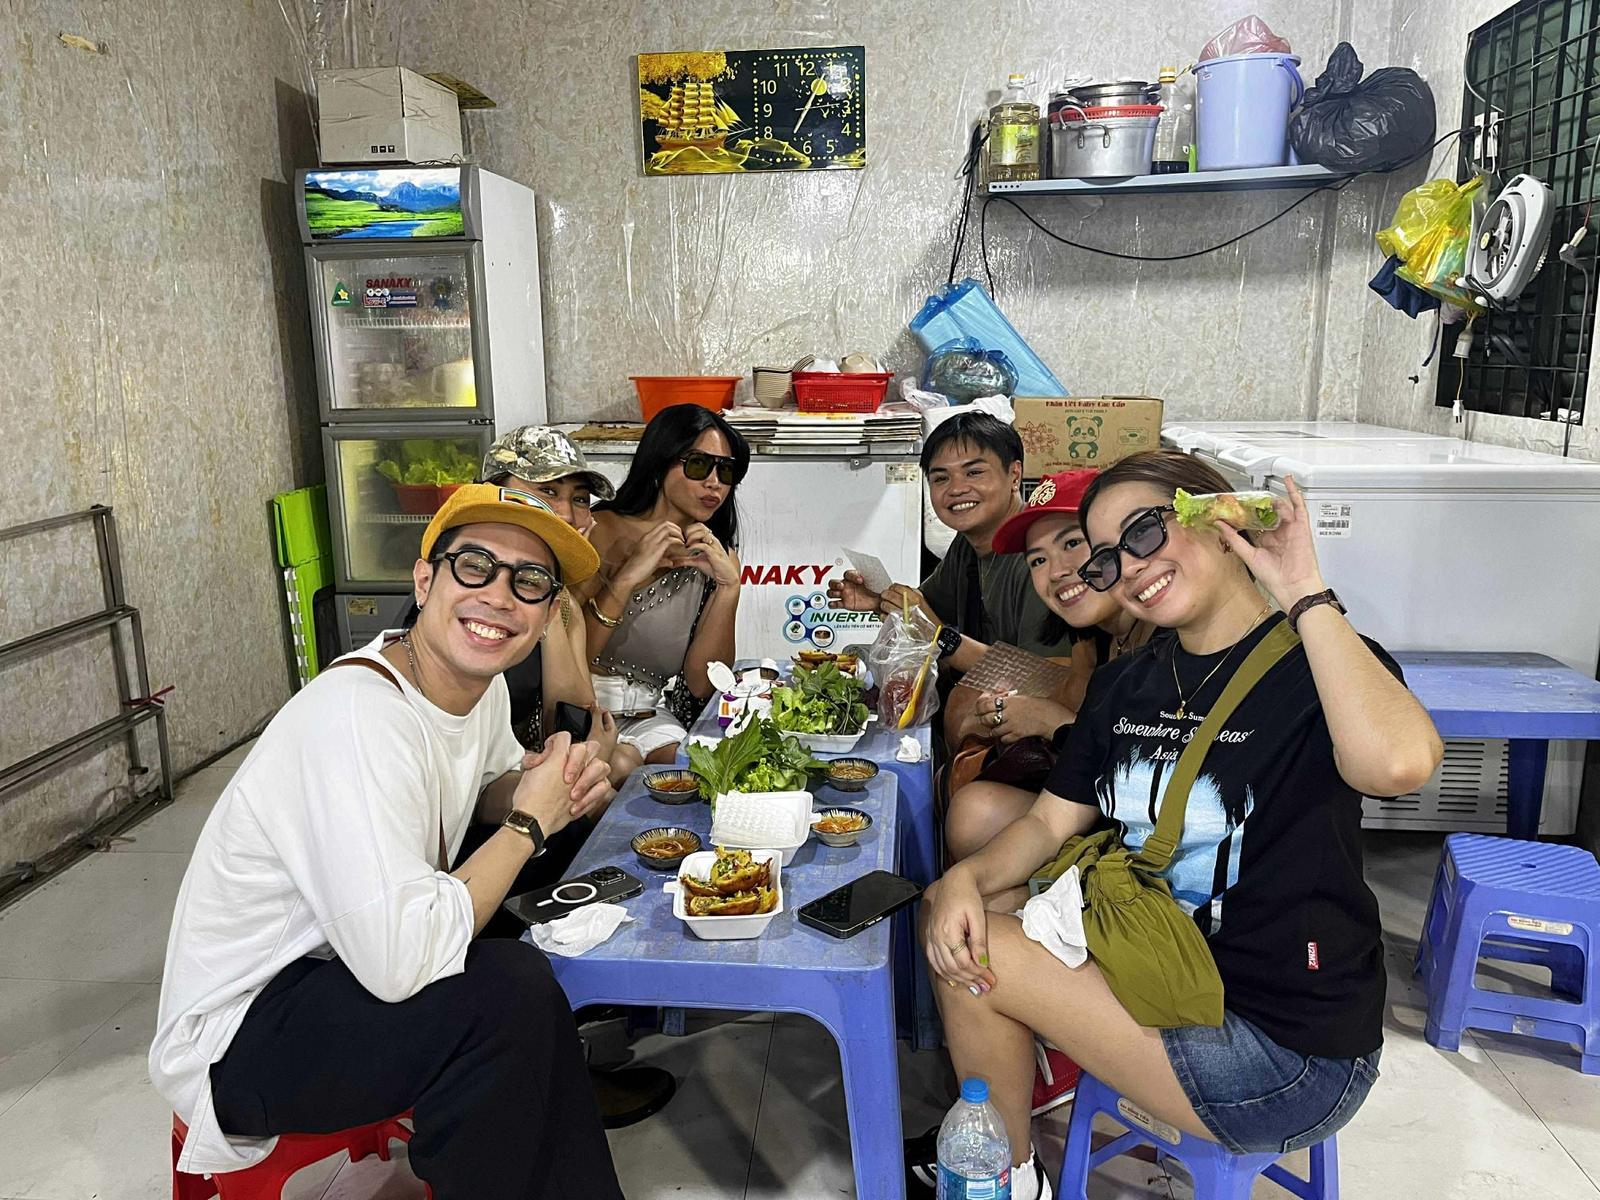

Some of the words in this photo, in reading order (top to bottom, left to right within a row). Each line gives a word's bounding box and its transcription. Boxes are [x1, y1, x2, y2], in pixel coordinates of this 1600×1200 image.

[774, 62, 789, 77] 11
[800, 61, 815, 76] 12
[760, 80, 777, 95] 10
[763, 103, 773, 118] 9
[763, 125, 774, 140] 8
[841, 122, 852, 137] 4
[803, 140, 812, 155] 6
[826, 139, 835, 153] 5
[366, 278, 412, 288] SANAKY
[741, 565, 833, 585] NAKY
[810, 612, 880, 622] INVERTE
